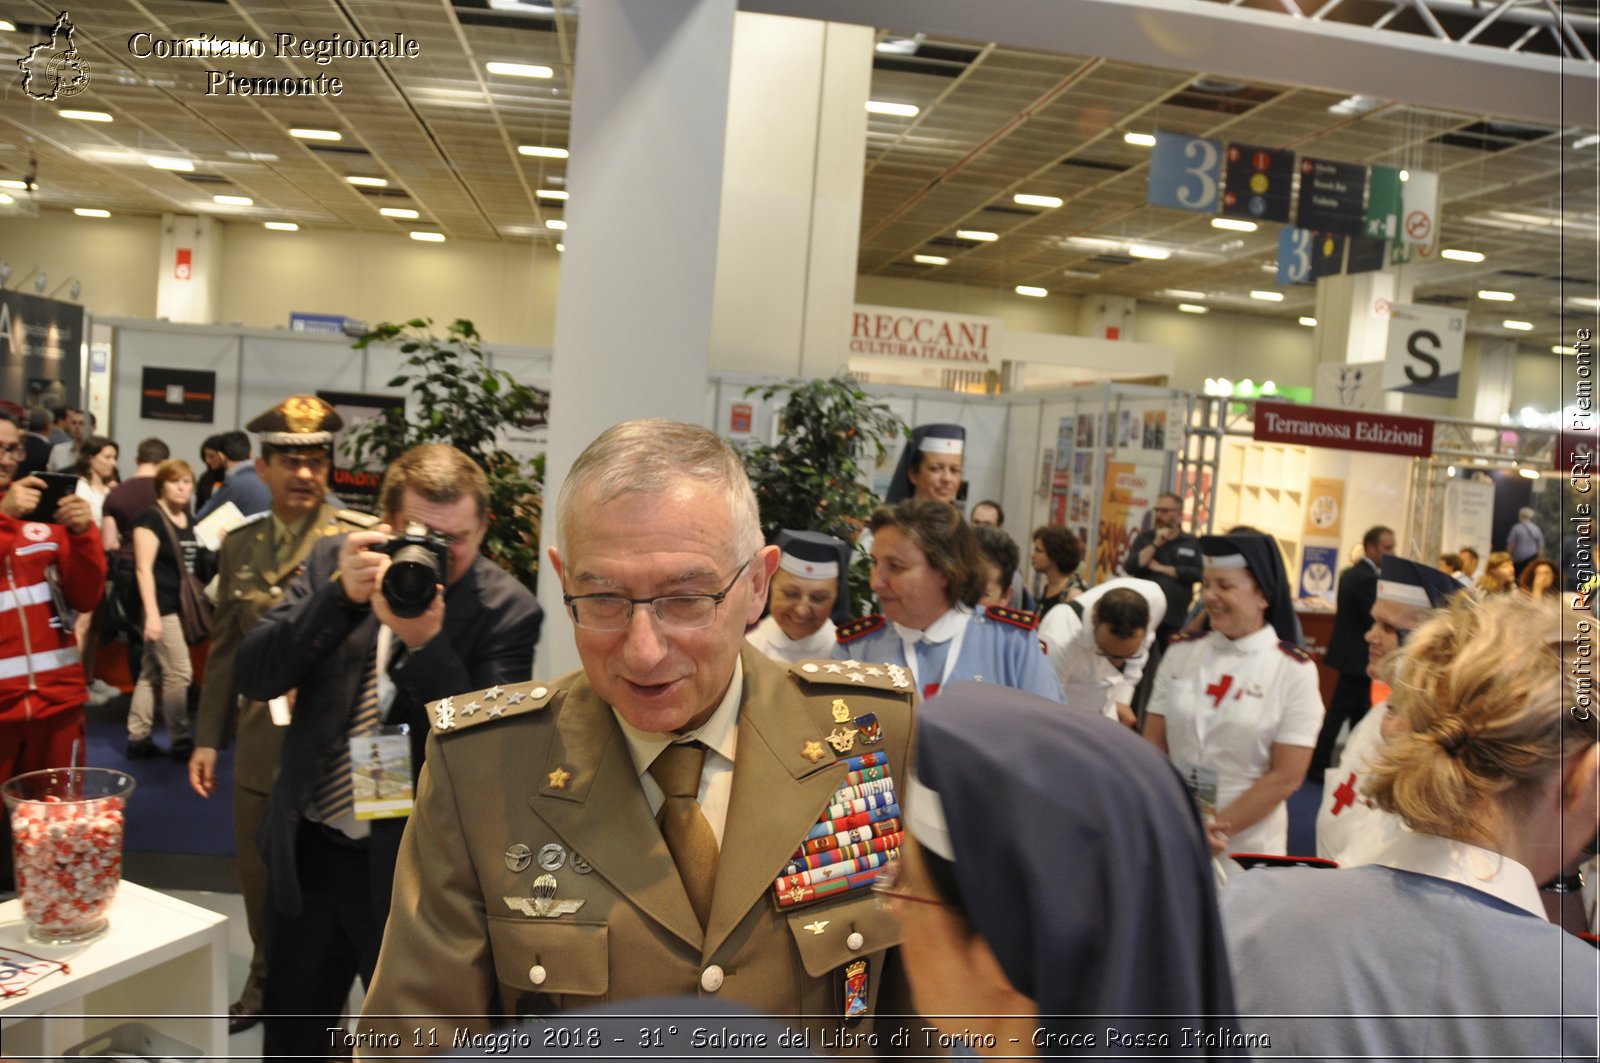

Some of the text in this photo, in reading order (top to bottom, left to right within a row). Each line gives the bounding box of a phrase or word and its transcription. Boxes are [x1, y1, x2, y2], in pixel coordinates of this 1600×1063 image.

[1177, 140, 1217, 208] 3
[1287, 228, 1310, 281] 3
[850, 338, 989, 362] CULTURA ITALIANA
[1404, 328, 1441, 384] S
[1264, 412, 1423, 447] Terrarossa Edizioni
